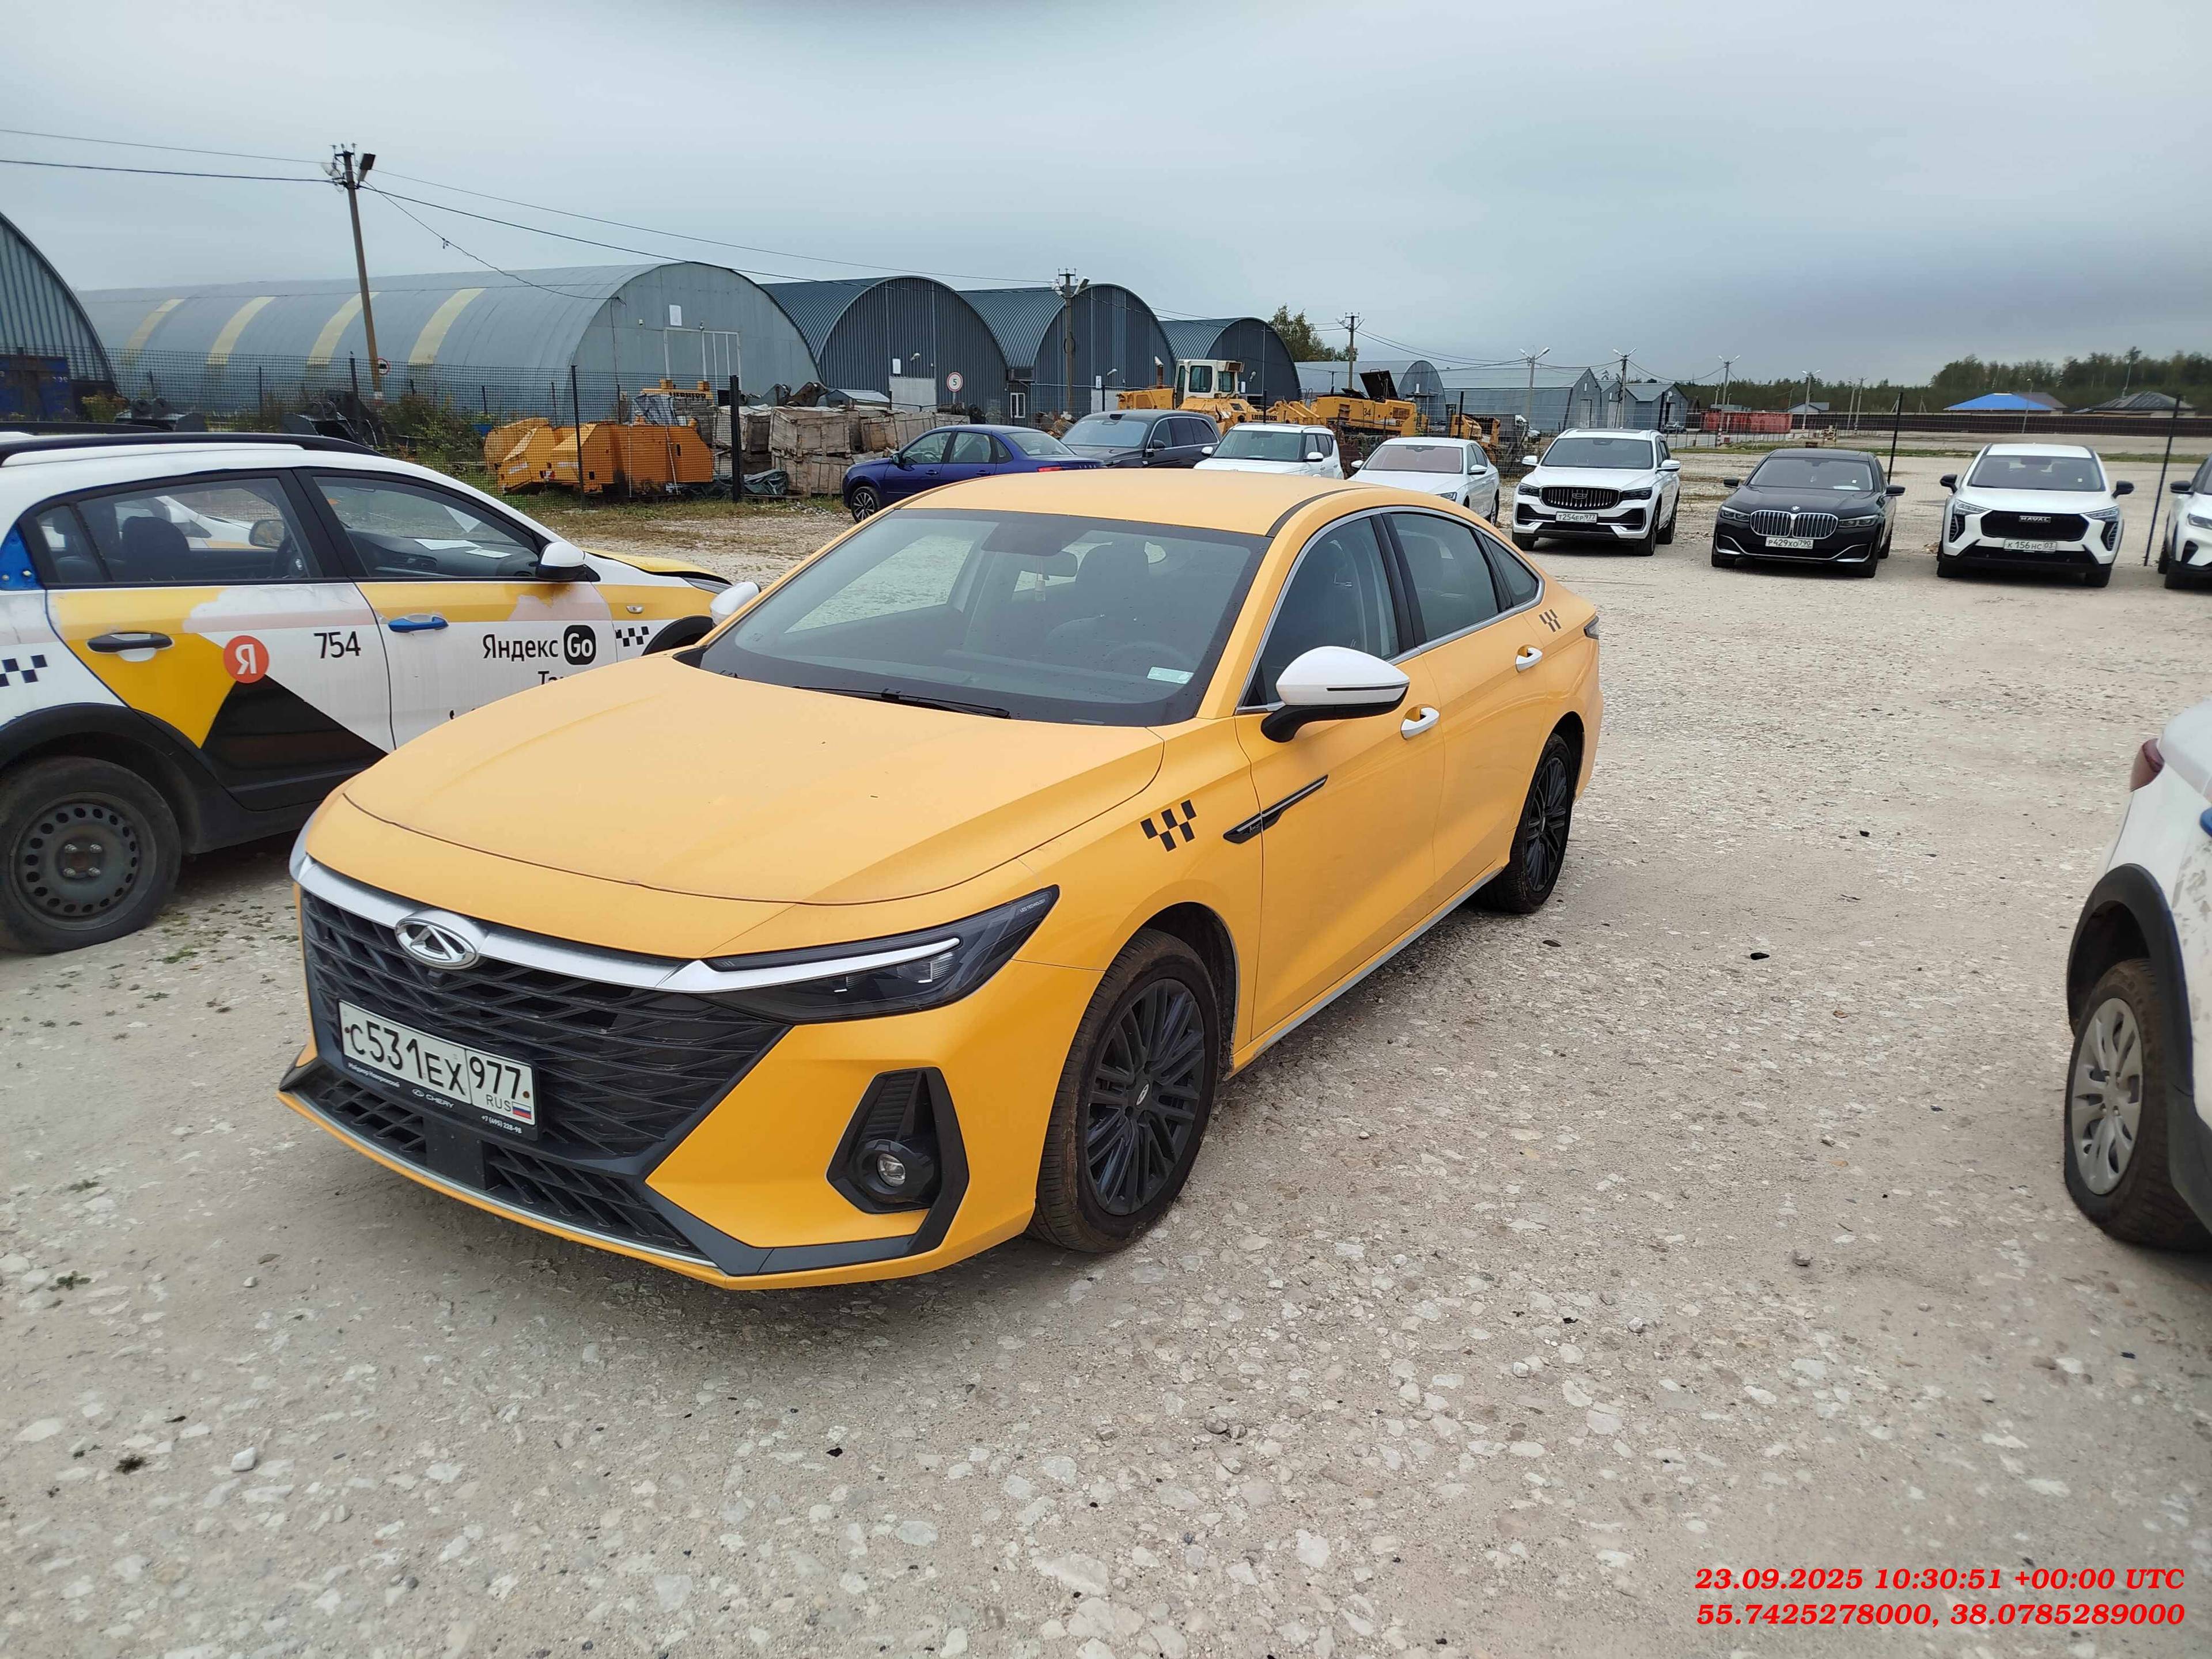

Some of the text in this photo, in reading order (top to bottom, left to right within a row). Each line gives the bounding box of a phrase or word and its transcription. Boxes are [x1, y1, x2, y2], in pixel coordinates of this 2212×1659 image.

[953, 378, 957, 386] 5
[314, 631, 361, 658] 754
[482, 632, 594, 662] Яндекс Go
[235, 643, 257, 675] Я
[426, 1094, 454, 1109] CHERY
[486, 1094, 512, 1112] RUS
